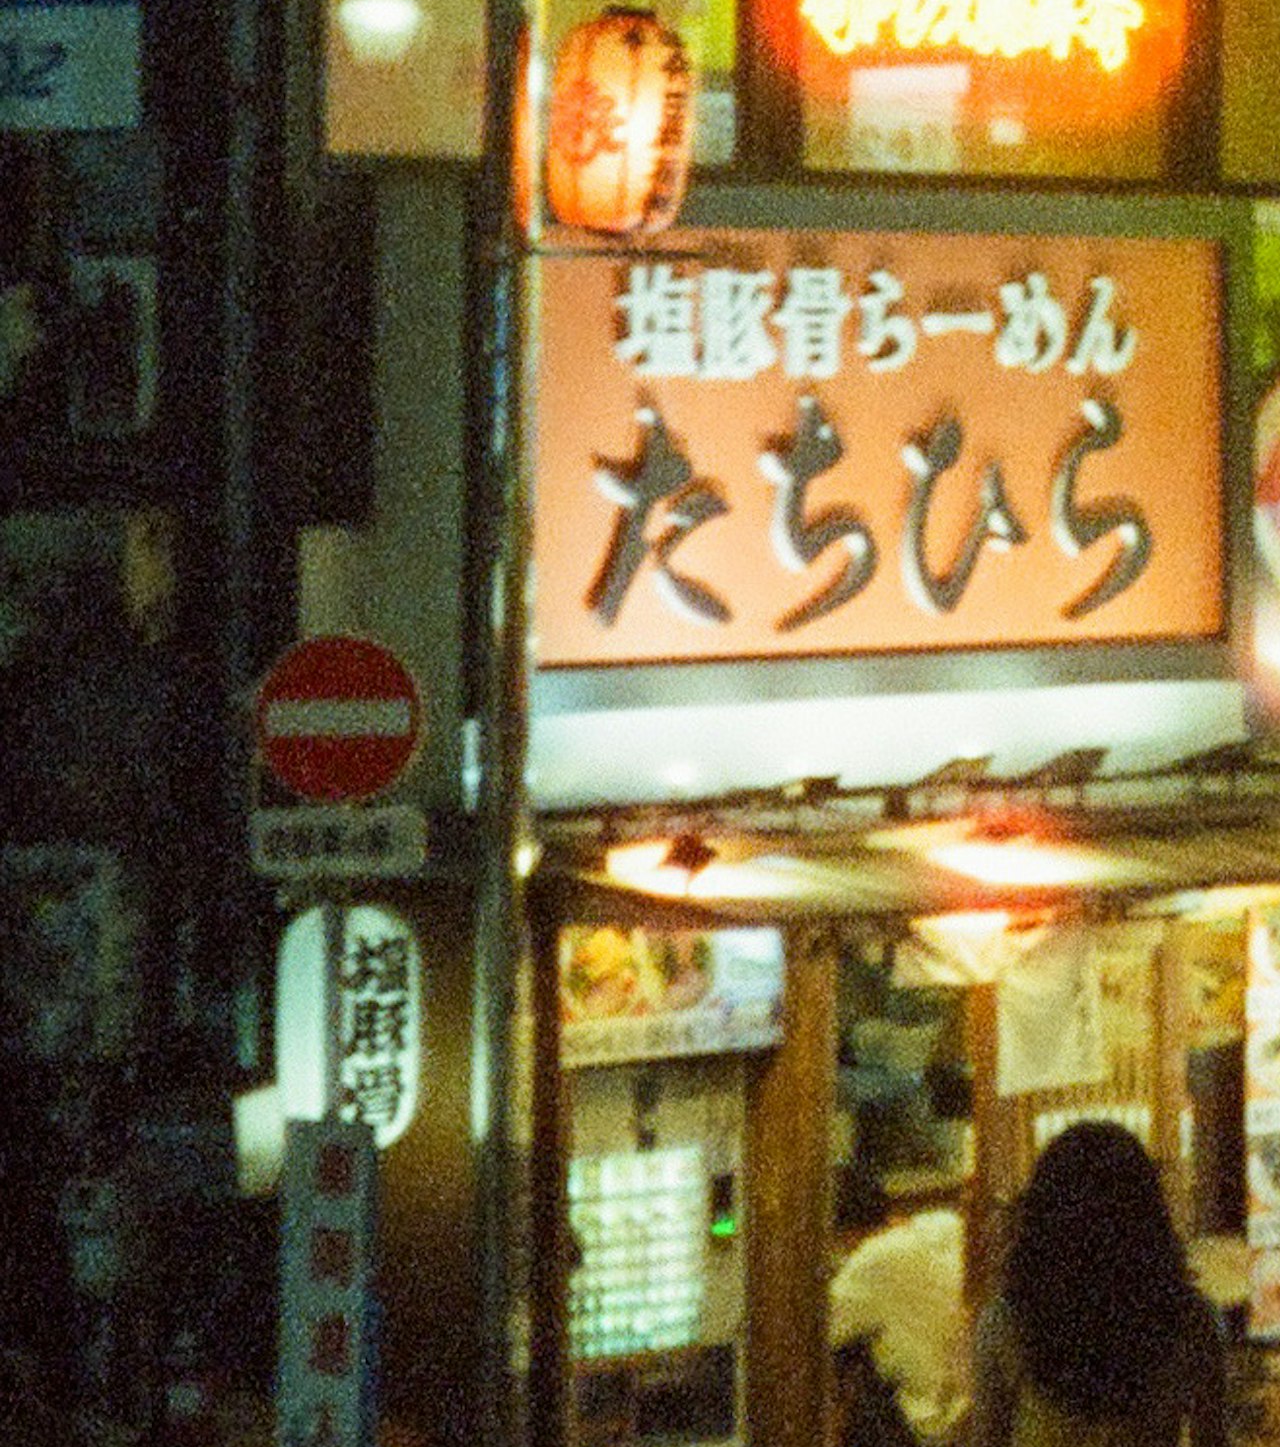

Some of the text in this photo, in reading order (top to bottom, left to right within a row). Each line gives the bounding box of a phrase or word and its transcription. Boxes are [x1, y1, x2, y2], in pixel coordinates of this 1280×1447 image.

[613, 264, 1137, 379] 塩豚骨らーめん
[586, 396, 1153, 632] たちひら
